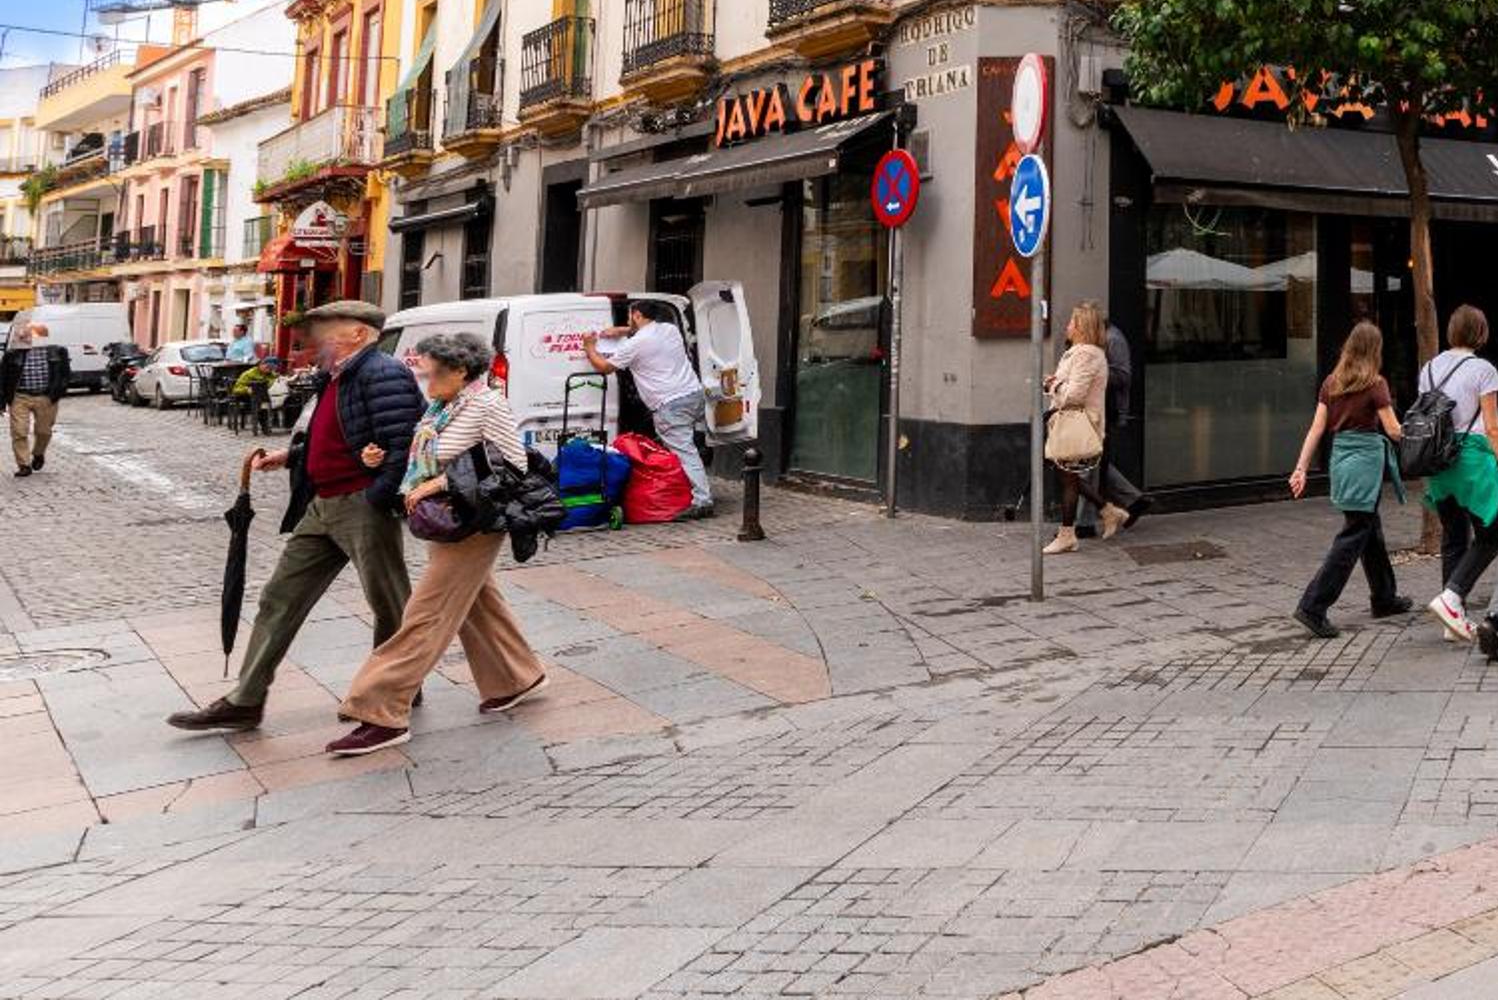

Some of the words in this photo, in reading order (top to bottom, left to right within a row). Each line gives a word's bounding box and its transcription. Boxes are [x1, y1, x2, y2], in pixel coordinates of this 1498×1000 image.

[900, 6, 975, 43] RODRIGO
[928, 43, 949, 66] DE
[904, 69, 969, 100] TRIANA
[715, 83, 786, 149] JAVA
[795, 59, 876, 124] CAFE
